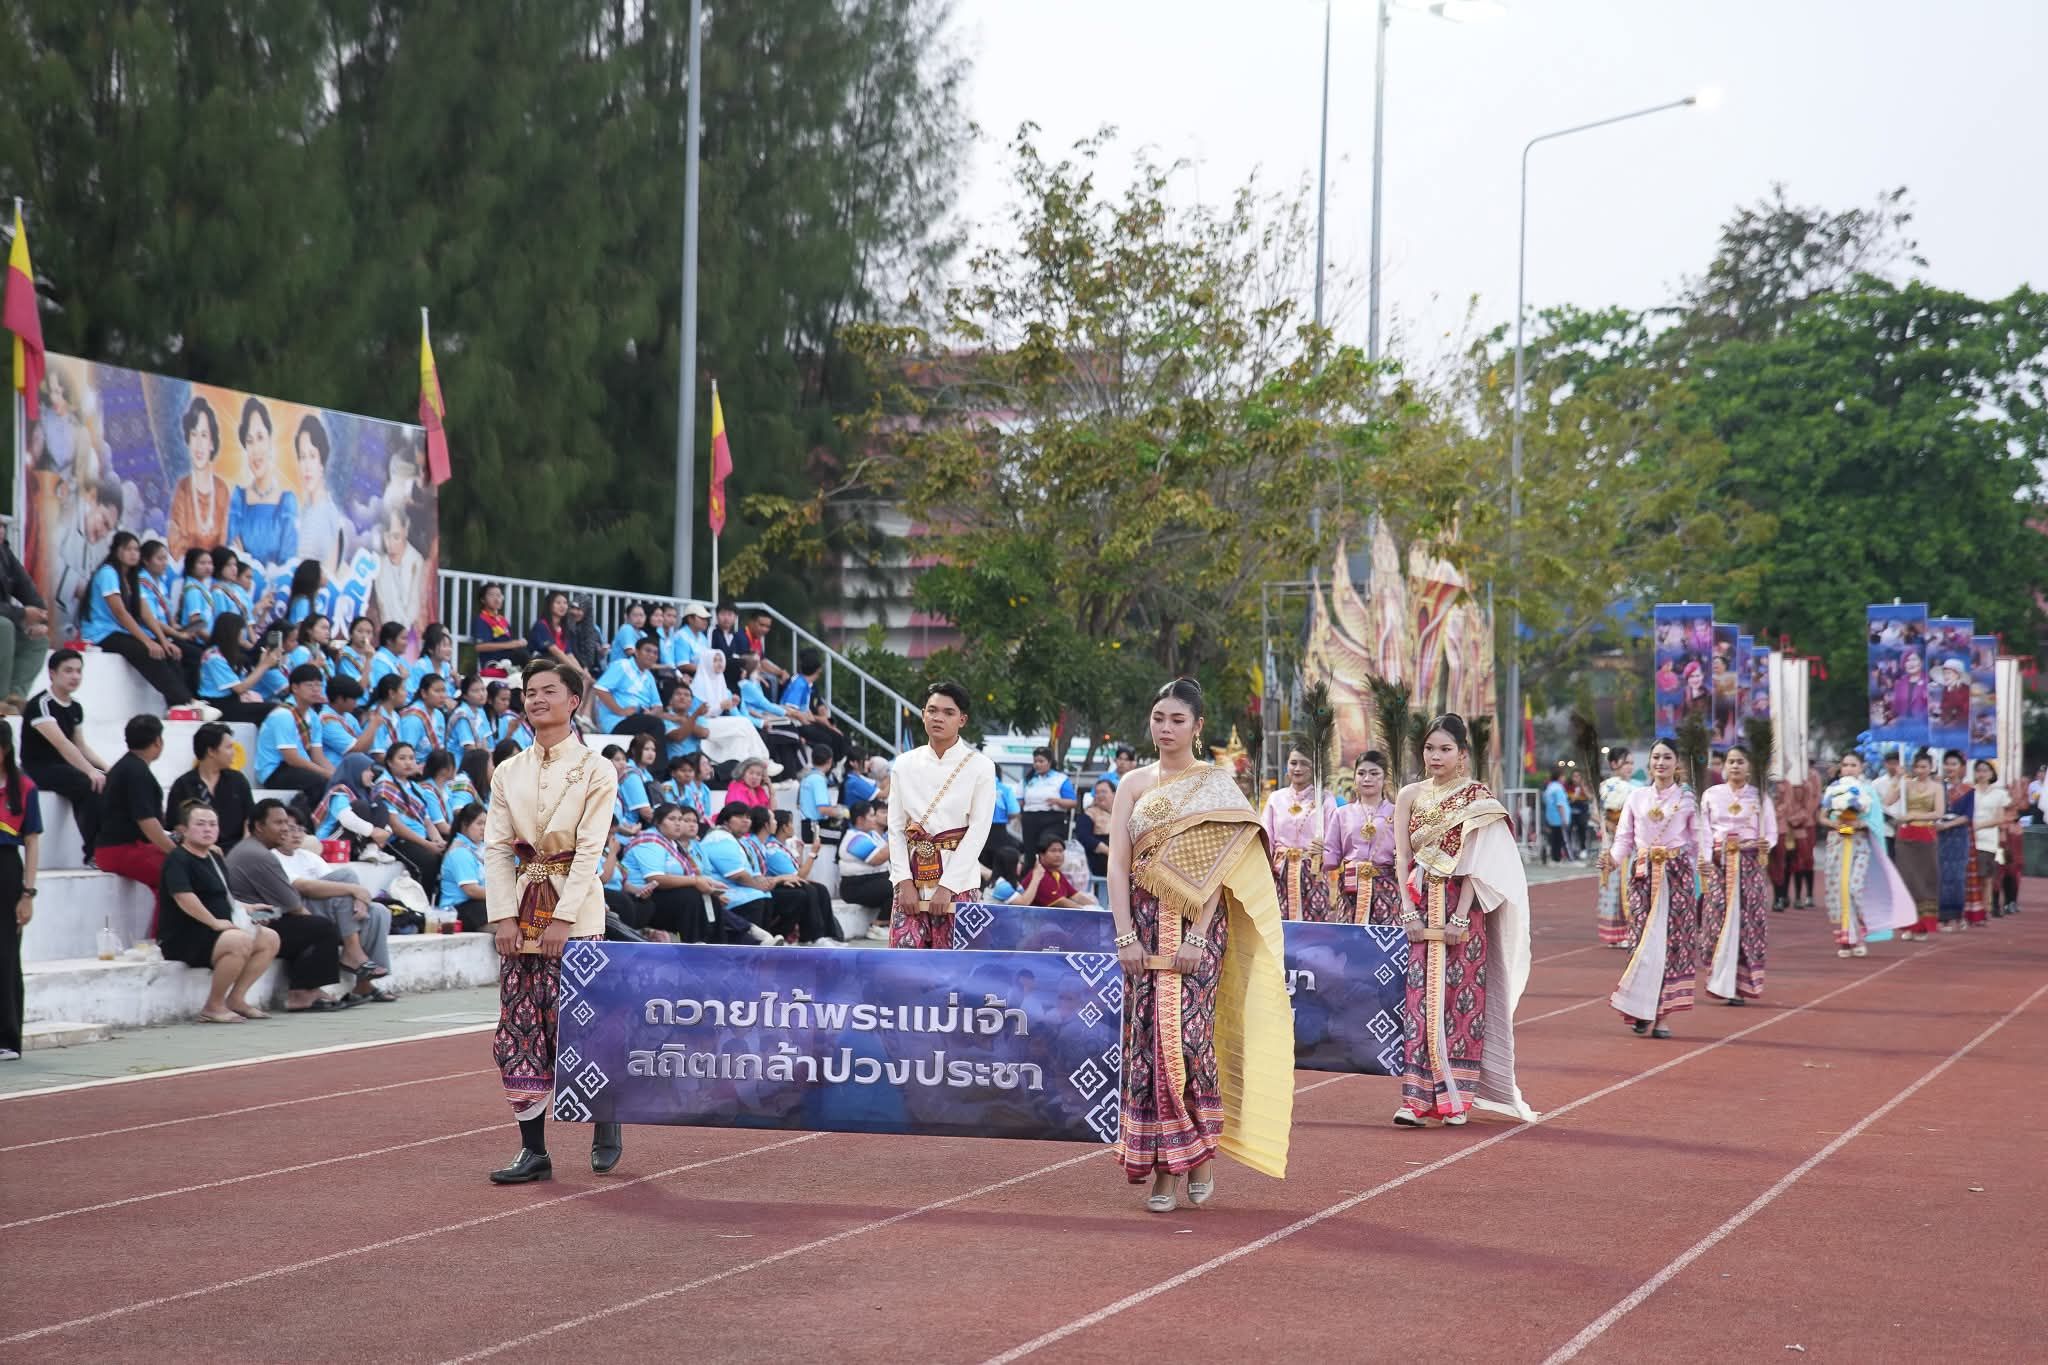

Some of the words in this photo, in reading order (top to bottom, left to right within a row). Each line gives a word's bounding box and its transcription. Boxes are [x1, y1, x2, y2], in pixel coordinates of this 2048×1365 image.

[644, 988, 1029, 1035] ถวายไท้พระแม่เจ้า
[626, 1041, 1044, 1091] สถิตเกล้าปวงประชา
